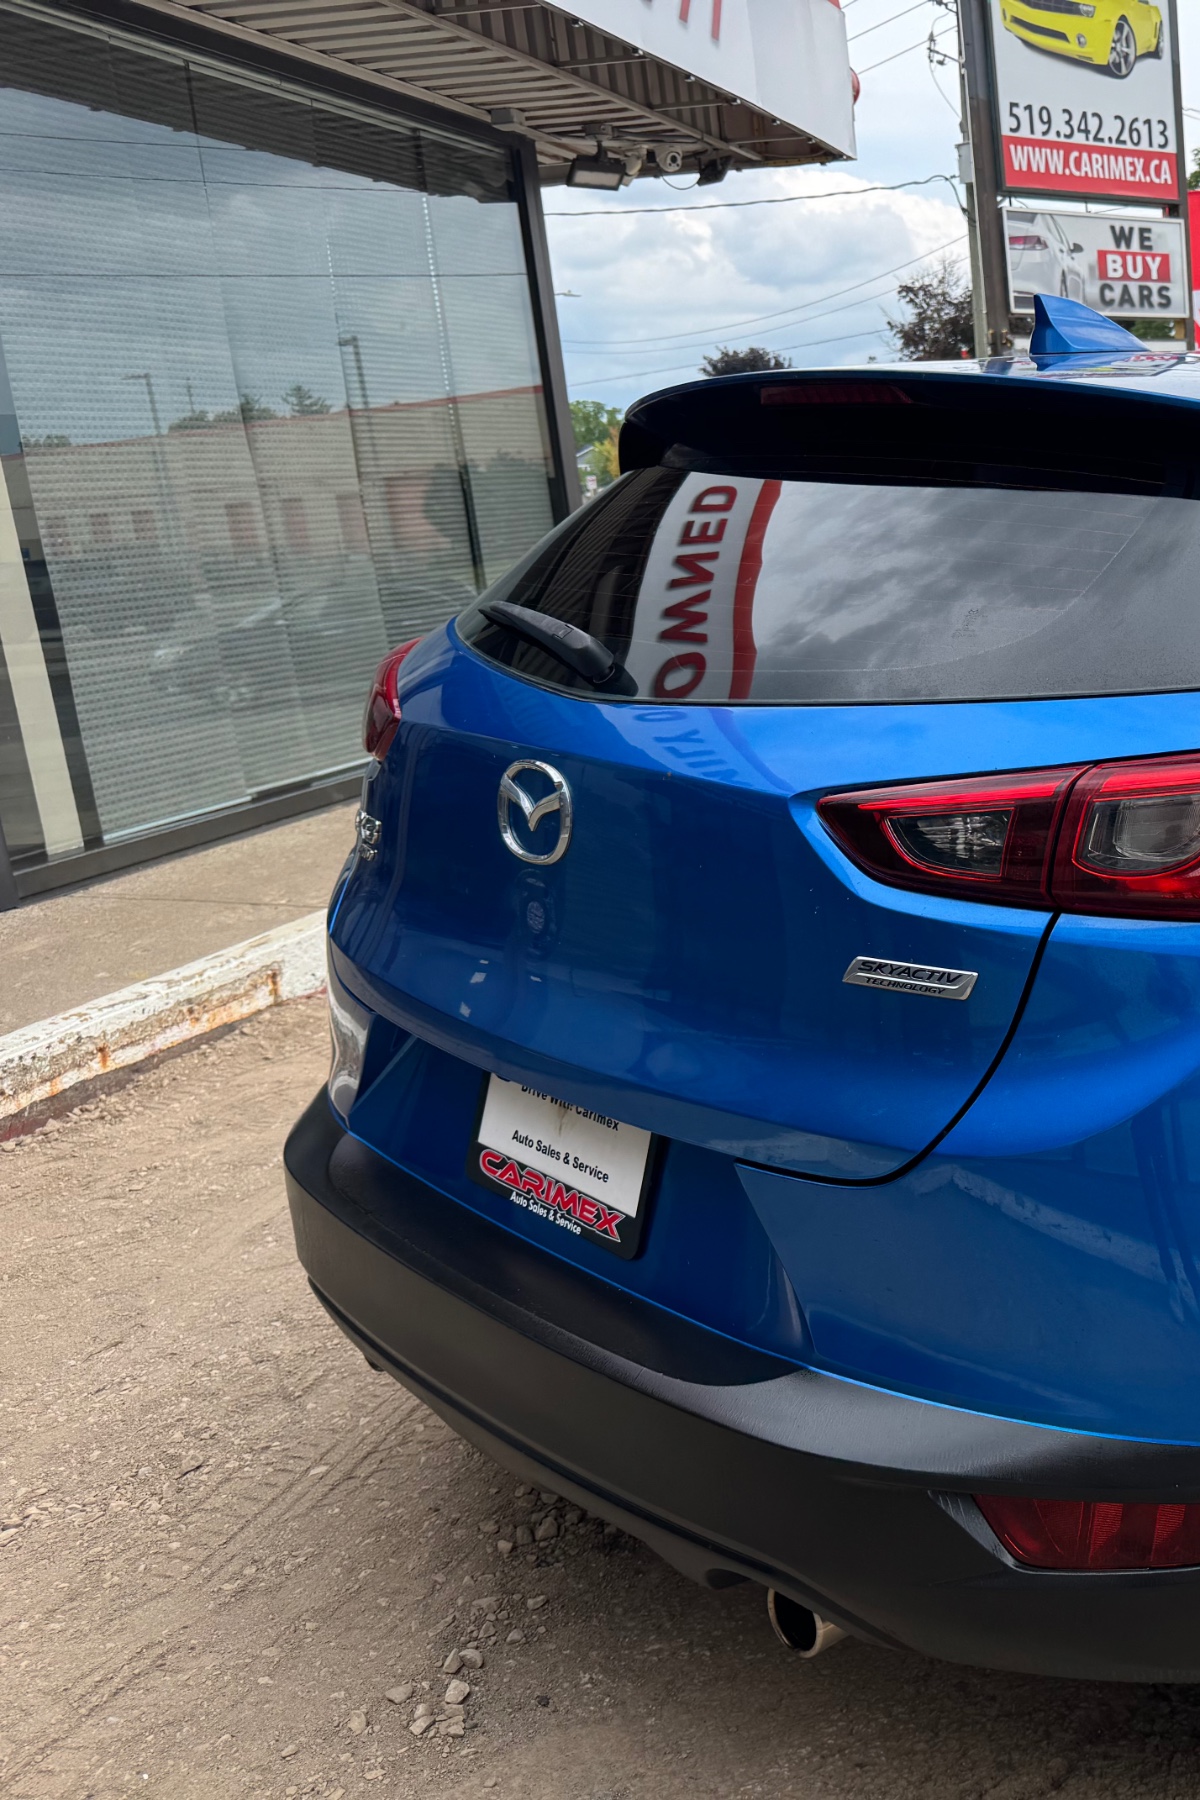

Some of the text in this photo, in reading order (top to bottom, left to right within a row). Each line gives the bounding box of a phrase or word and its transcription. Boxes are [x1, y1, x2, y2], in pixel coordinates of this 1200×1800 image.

[1008, 101, 1169, 149] 519.342.2613
[1009, 144, 1172, 185] WWW.CARIMEX.CA
[1110, 225, 1153, 251] WE
[1106, 254, 1161, 280] BUY
[1100, 283, 1171, 309] CARS
[858, 961, 963, 984] SKYACTIV
[865, 976, 946, 995] TECHNOLOGY
[511, 1130, 609, 1183] Auto Sales & Service
[480, 1149, 625, 1242] CARIMEX
[510, 1191, 582, 1235] Auto Sales & Service
